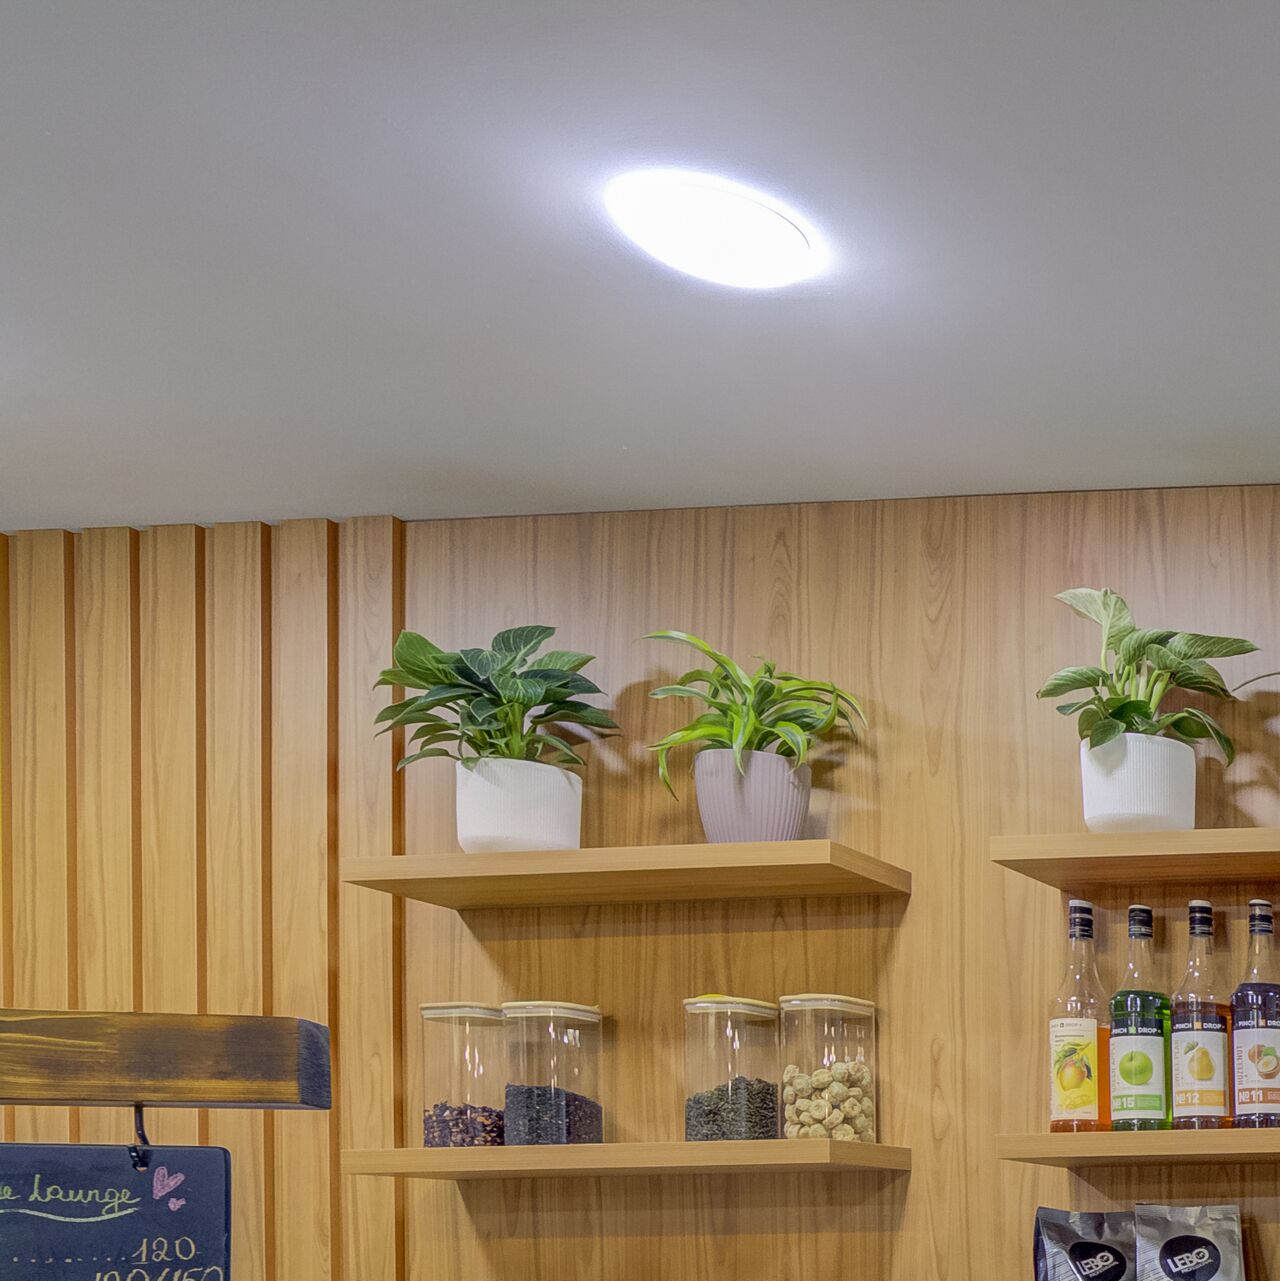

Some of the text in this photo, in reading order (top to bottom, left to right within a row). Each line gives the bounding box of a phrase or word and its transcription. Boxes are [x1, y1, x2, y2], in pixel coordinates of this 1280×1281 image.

[1137, 1026, 1157, 1034] DROP
[28, 1174, 141, 1216] Lounge
[132, 1237, 196, 1264] 120
[1076, 1251, 1115, 1276] LEBO
[1166, 1248, 1210, 1274] LEBO
